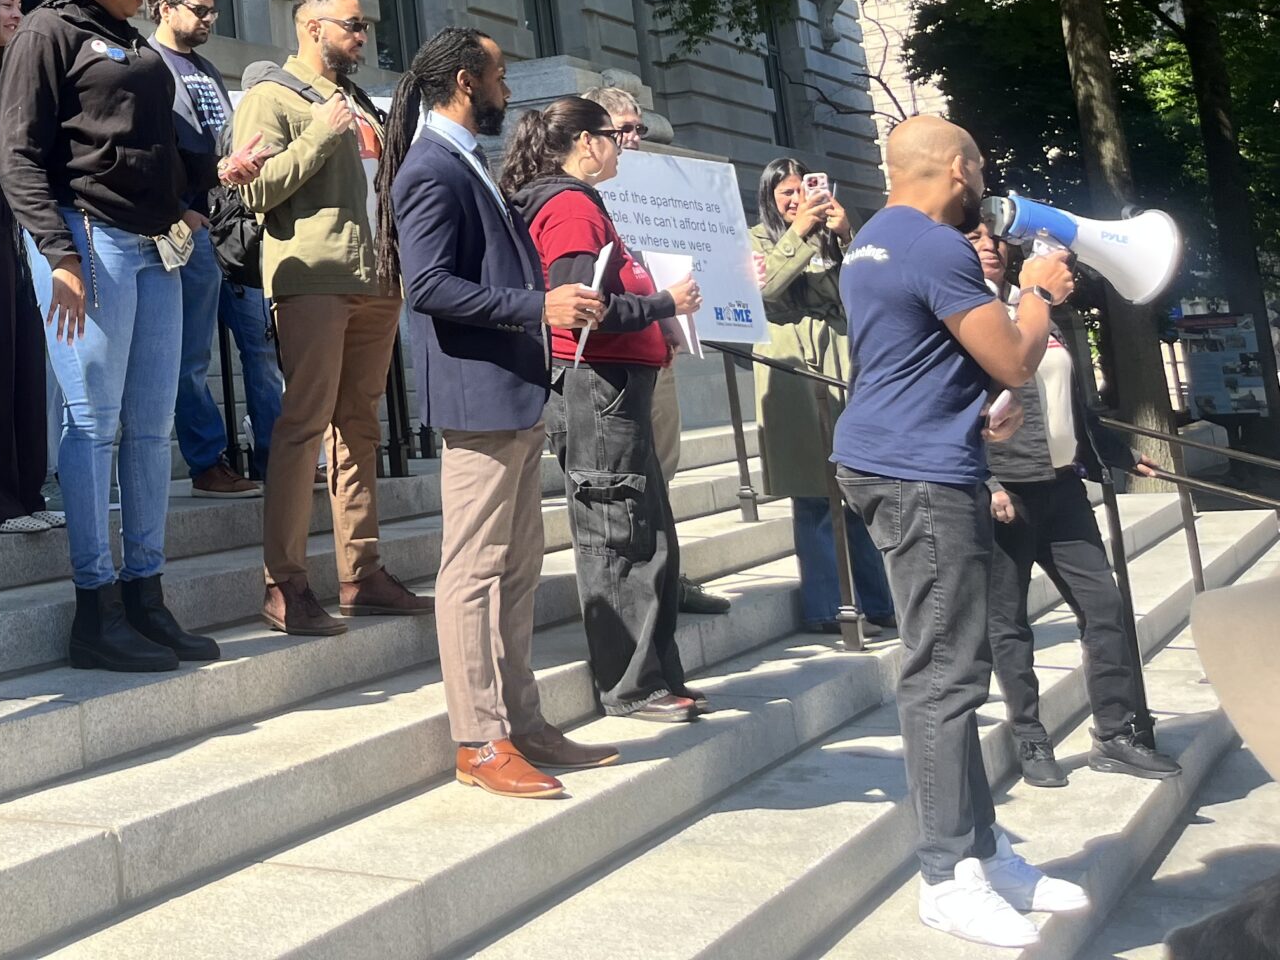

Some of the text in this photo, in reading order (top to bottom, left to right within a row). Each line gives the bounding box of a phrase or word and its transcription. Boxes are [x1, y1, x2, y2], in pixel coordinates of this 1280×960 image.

[600, 189, 721, 214] one of the apartments are
[633, 211, 652, 226] We
[679, 217, 706, 233] afford
[708, 220, 718, 234] to
[719, 221, 736, 235] live
[638, 233, 670, 249] where
[670, 239, 686, 250] we
[688, 240, 712, 253] were
[1100, 230, 1129, 245] PYLE
